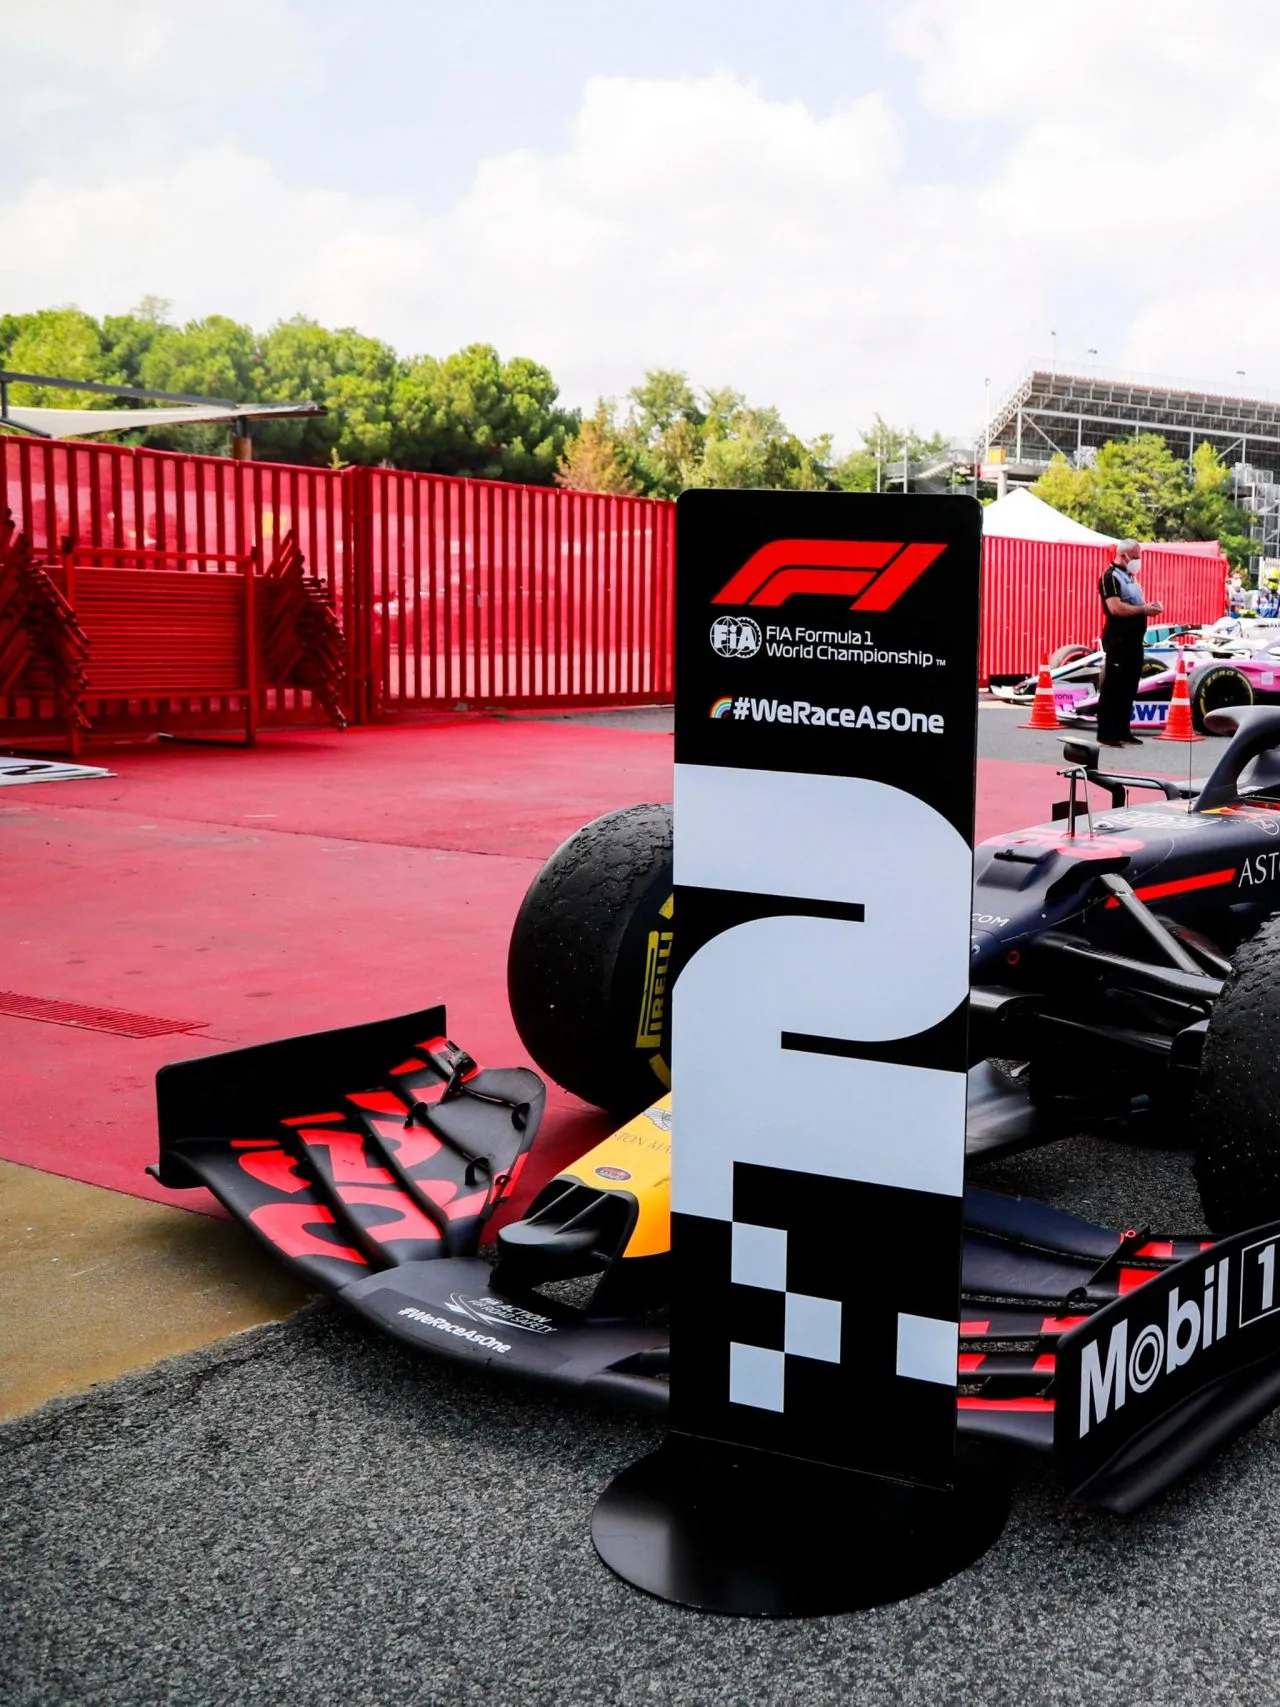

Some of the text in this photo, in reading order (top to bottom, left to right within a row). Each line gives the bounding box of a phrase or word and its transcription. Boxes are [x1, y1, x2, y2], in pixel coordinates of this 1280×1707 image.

[710, 538, 948, 612] F1
[766, 626, 874, 646] FIA Formula 1
[766, 642, 814, 659] World
[816, 645, 934, 668] Championship
[732, 696, 945, 735] #WeRaceAsOne
[635, 929, 674, 1049] PIRELLI
[670, 763, 973, 1221] 2
[397, 1306, 512, 1354] #WeRaceAsOne
[1079, 1256, 1230, 1439] Mobil
